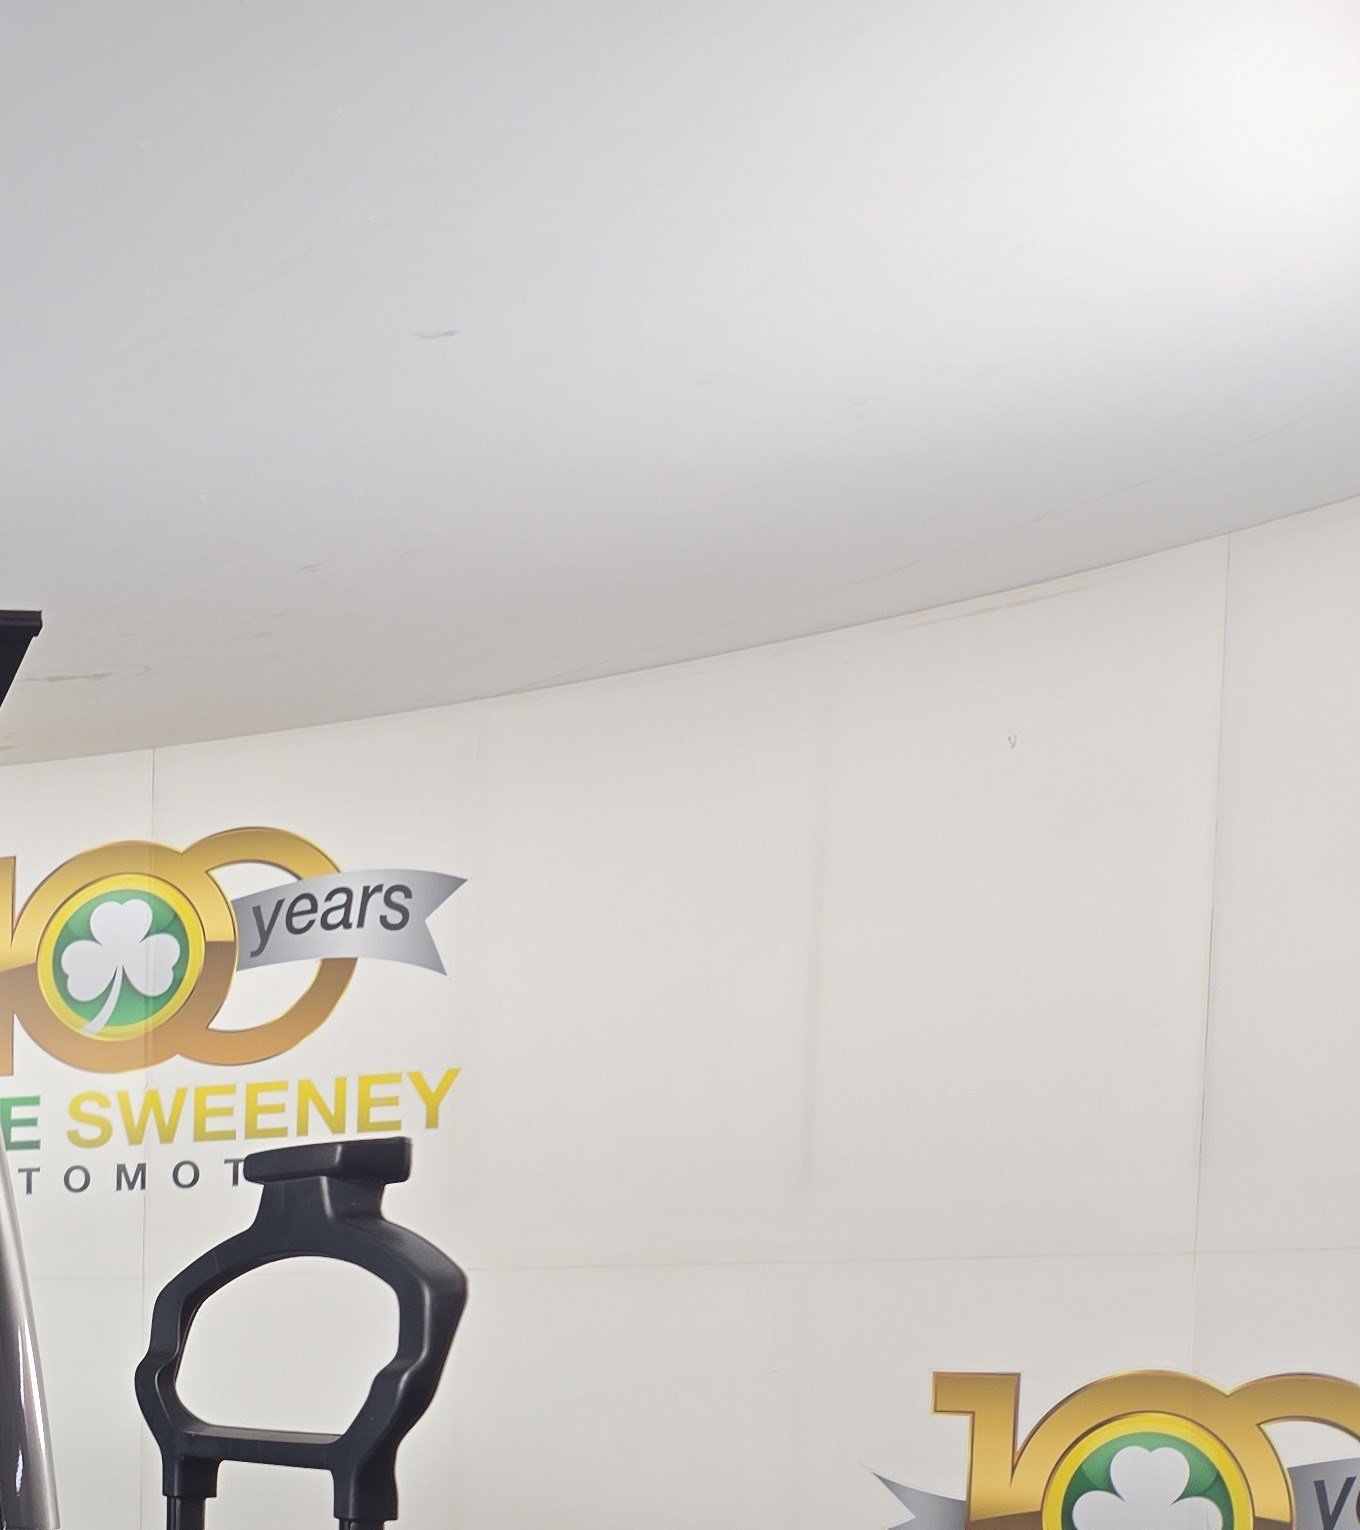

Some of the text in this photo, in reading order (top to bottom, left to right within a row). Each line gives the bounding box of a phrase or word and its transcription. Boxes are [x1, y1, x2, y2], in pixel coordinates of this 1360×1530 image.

[250, 877, 412, 958] years
[66, 1068, 462, 1149] SWEENEY
[18, 1158, 245, 1195] TOMOT
